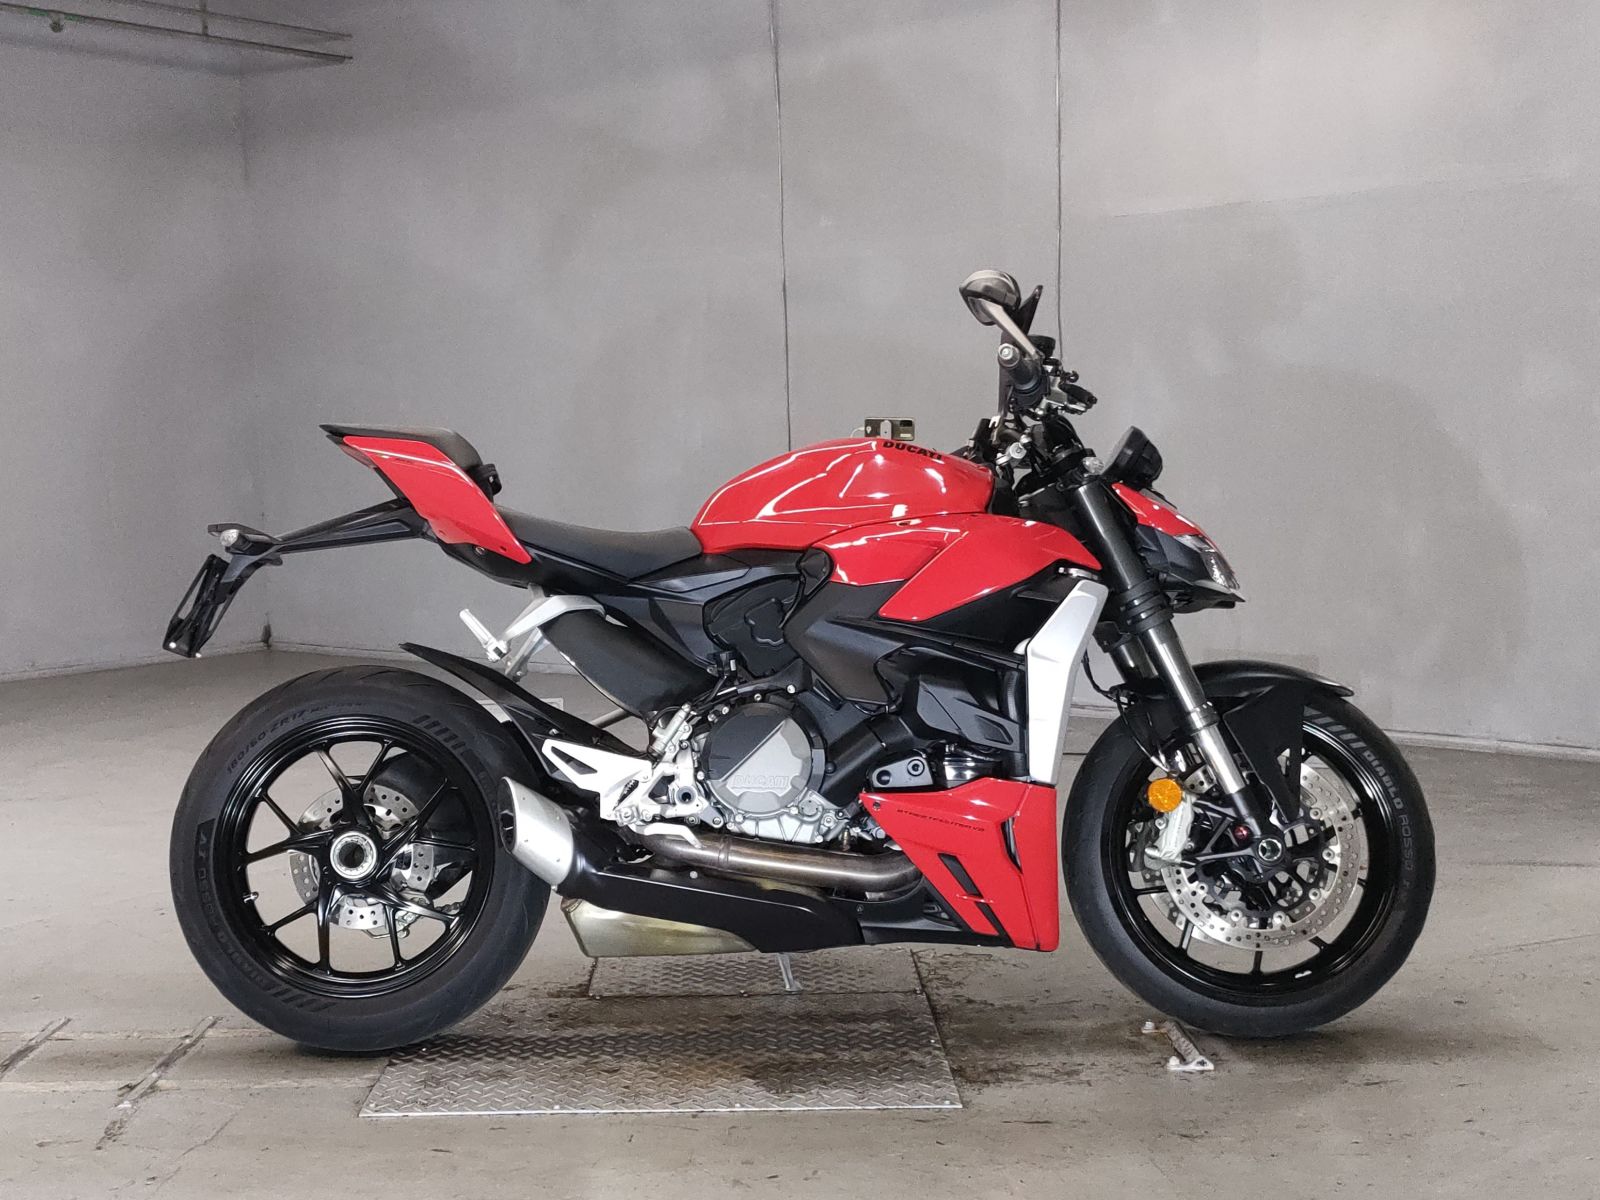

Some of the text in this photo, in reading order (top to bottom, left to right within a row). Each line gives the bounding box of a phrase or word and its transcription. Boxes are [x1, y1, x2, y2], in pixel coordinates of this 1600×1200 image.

[883, 441, 942, 460] DUCATI
[733, 775, 789, 787] DUCATI
[1362, 750, 1415, 872] DIABLO ROSSO
